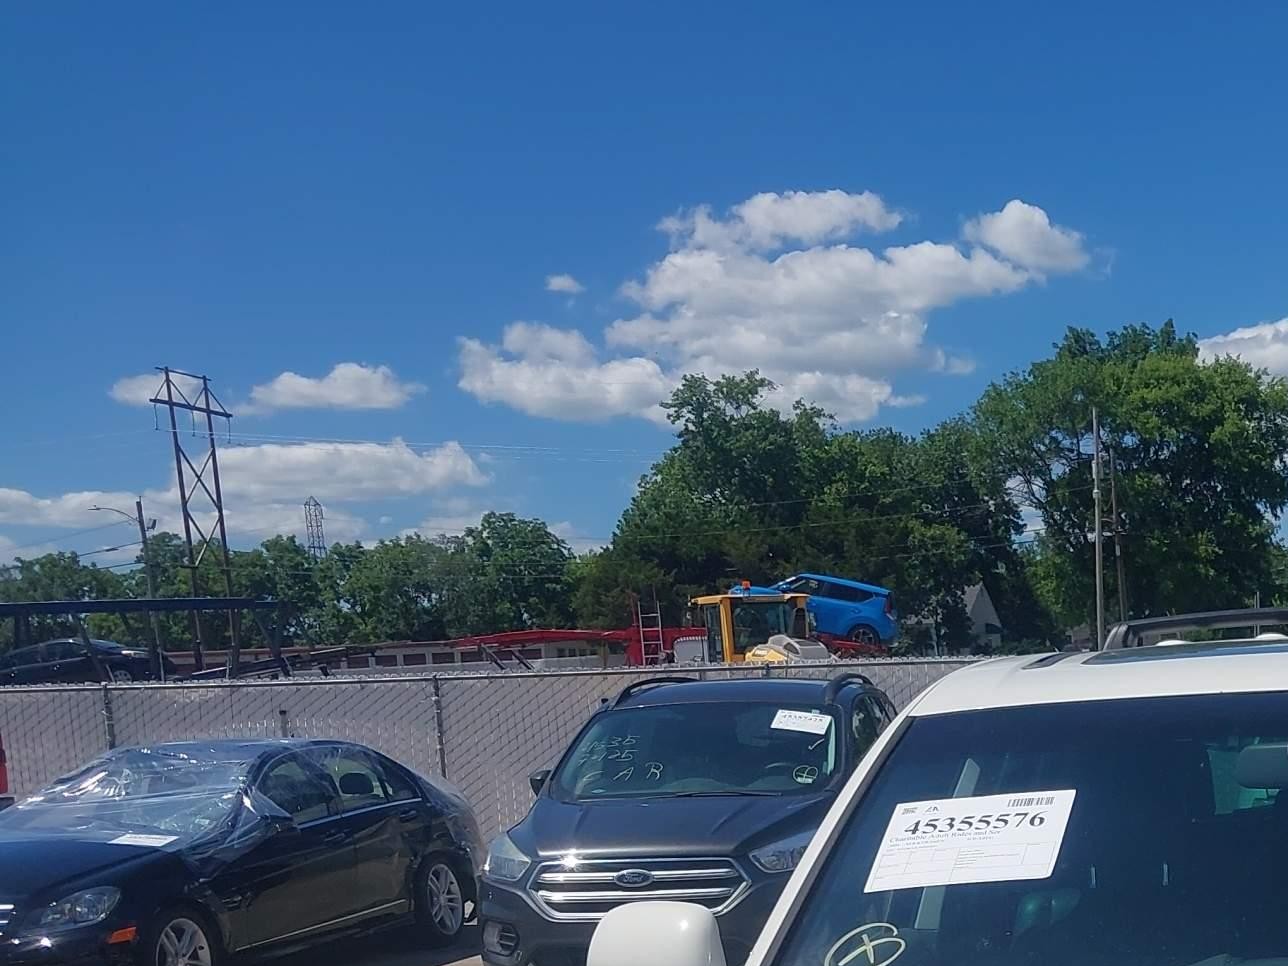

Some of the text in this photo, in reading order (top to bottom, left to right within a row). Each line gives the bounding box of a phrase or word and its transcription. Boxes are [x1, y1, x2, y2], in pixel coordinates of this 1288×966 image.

[903, 810, 1049, 835] 45355576
[889, 834, 927, 844] Charitable
[622, 872, 644, 884] Ford
